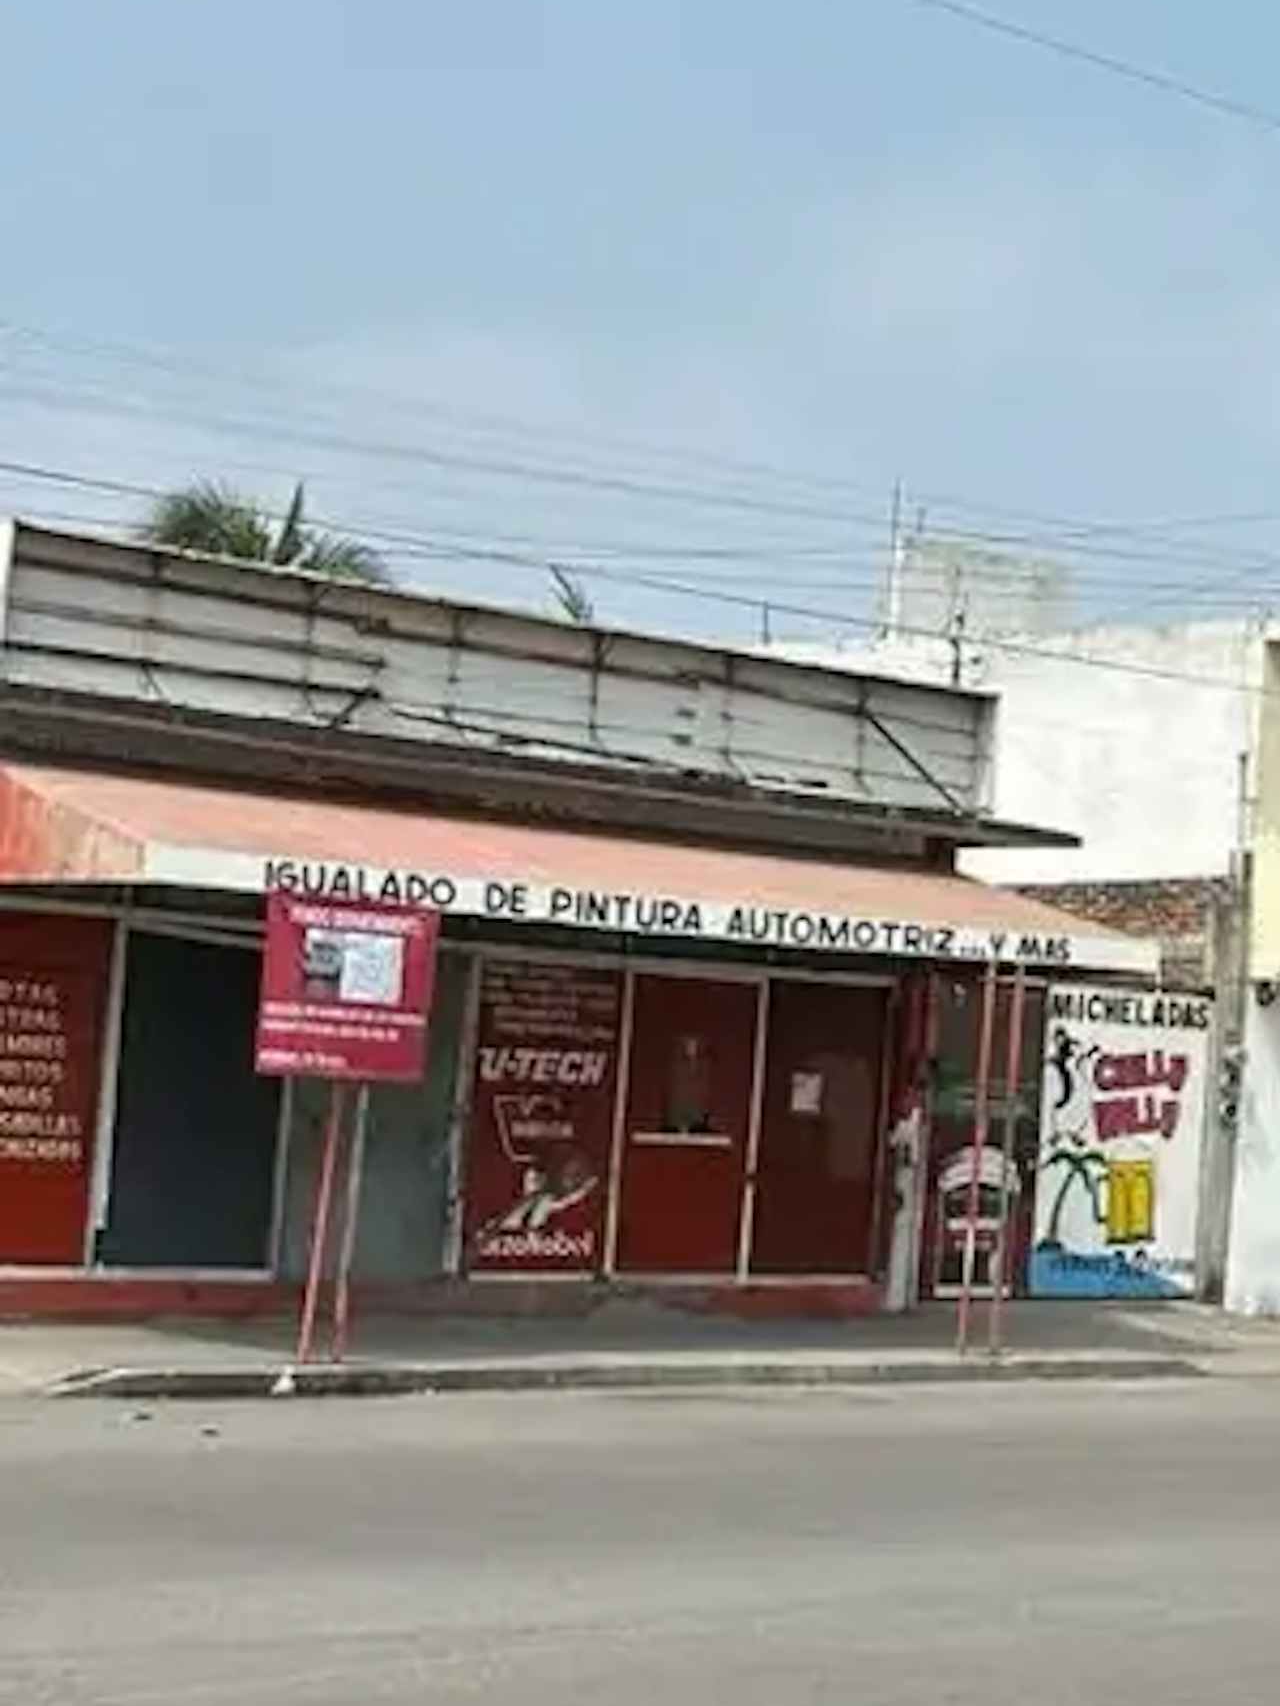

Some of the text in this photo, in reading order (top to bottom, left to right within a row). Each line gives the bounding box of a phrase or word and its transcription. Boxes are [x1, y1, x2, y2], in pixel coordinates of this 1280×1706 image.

[264, 861, 457, 905] IGUALADO
[485, 883, 529, 916] DE
[551, 890, 703, 934] PINTURA
[1016, 937, 1072, 962] MAS
[1053, 992, 1209, 1031] MICHELADAS
